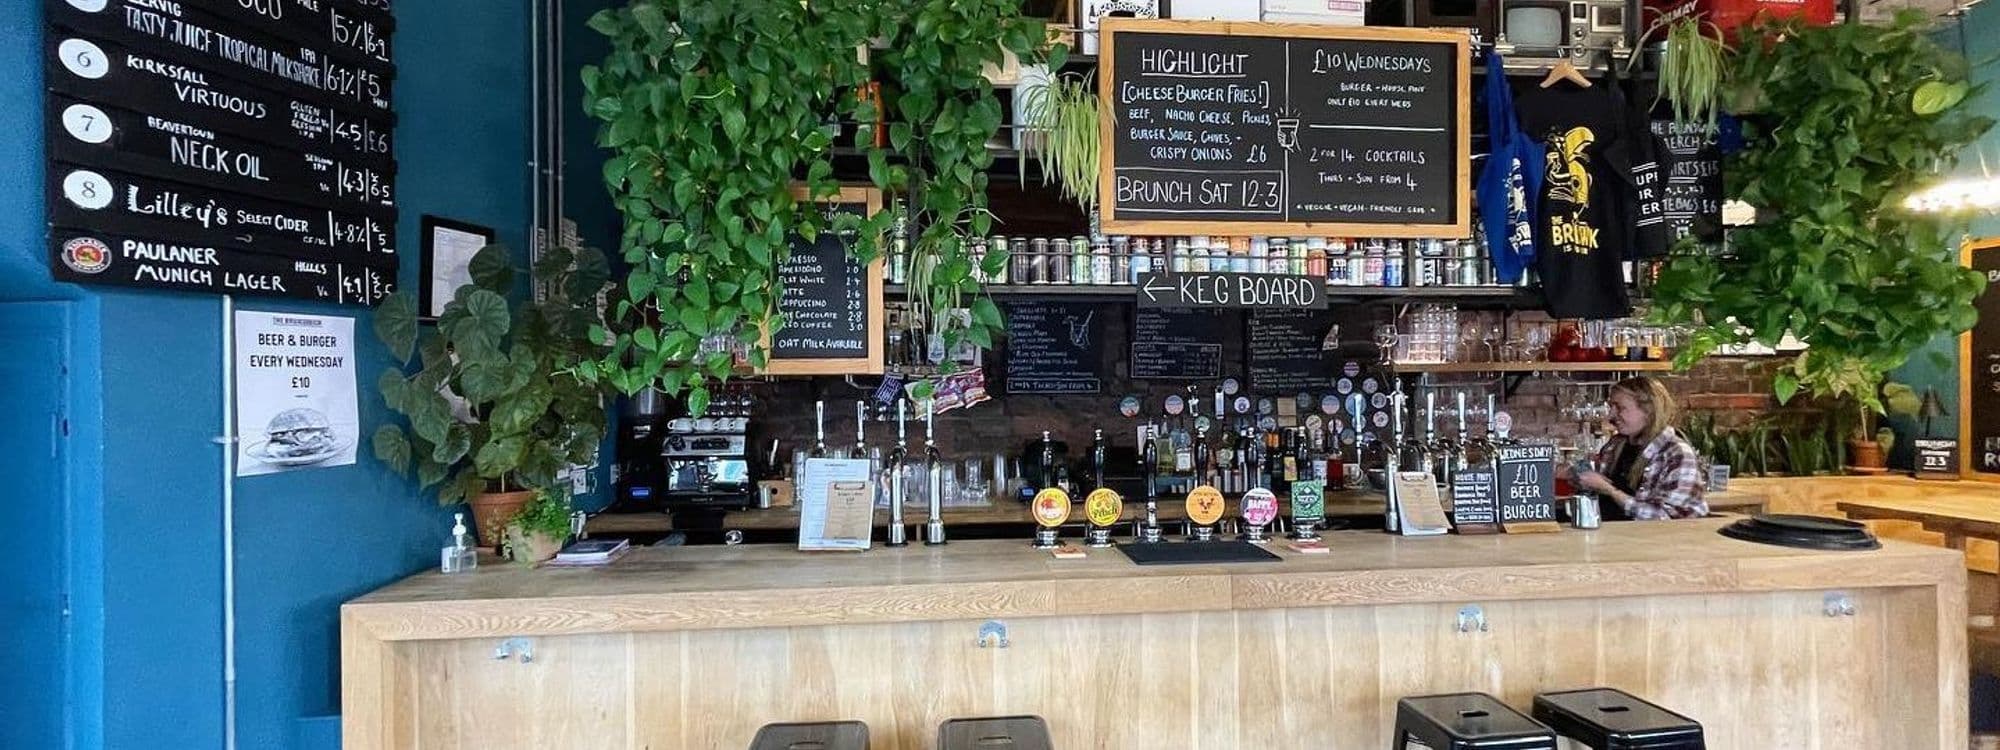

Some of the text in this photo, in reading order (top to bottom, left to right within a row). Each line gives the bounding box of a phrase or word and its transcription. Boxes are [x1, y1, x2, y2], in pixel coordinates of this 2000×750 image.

[123, 4, 167, 38] TASTY
[215, 32, 271, 72] TROPICAL
[77, 51, 91, 67] 6
[1142, 49, 1249, 74] HIGHLIGHT
[1312, 49, 1432, 73] £10 WEDNESDAYS
[127, 54, 208, 86] KIRKSTALL
[1175, 84, 1224, 103] BURGER
[1340, 82, 1373, 92] BURGER
[174, 82, 267, 119] VIRTUOUS
[81, 115, 94, 131] 7
[1165, 109, 1195, 122] NACHO
[1199, 111, 1235, 126] CHEESE,
[147, 116, 215, 140] BEAVERTOWN
[1130, 127, 1165, 140] BURGER
[1167, 129, 1197, 144] SAUCE,
[1651, 121, 1665, 135] HE
[369, 130, 388, 153] £6
[171, 137, 270, 181] NECK OIL
[1150, 144, 1267, 163] CRISPY ONIONS £6
[1309, 148, 1318, 162] 2
[1340, 148, 1355, 162] 14
[1365, 150, 1425, 165] COCKTAILS
[82, 181, 96, 198] 8
[1117, 176, 1279, 207] BRUNCH SAT 12-3
[1356, 172, 1373, 184] SUN
[1380, 174, 1401, 184] FROM
[1406, 172, 1418, 192] 4
[128, 184, 228, 228] Lilley's
[274, 214, 309, 233] CIDER
[122, 240, 220, 265] PAULANER
[135, 264, 286, 292] MUNICH LAGER
[799, 276, 825, 284] WHITE
[1179, 275, 1316, 306] KEG BOARD
[258, 333, 337, 348] BEER & BURGER
[778, 339, 799, 348] OAT
[802, 338, 825, 348] MILK
[250, 355, 344, 368] EVERY WEDNESDAY
[292, 377, 310, 388] £10
[1513, 464, 1538, 485] £10
[1511, 485, 1541, 499] BEER
[1503, 503, 1551, 520] BURGER
